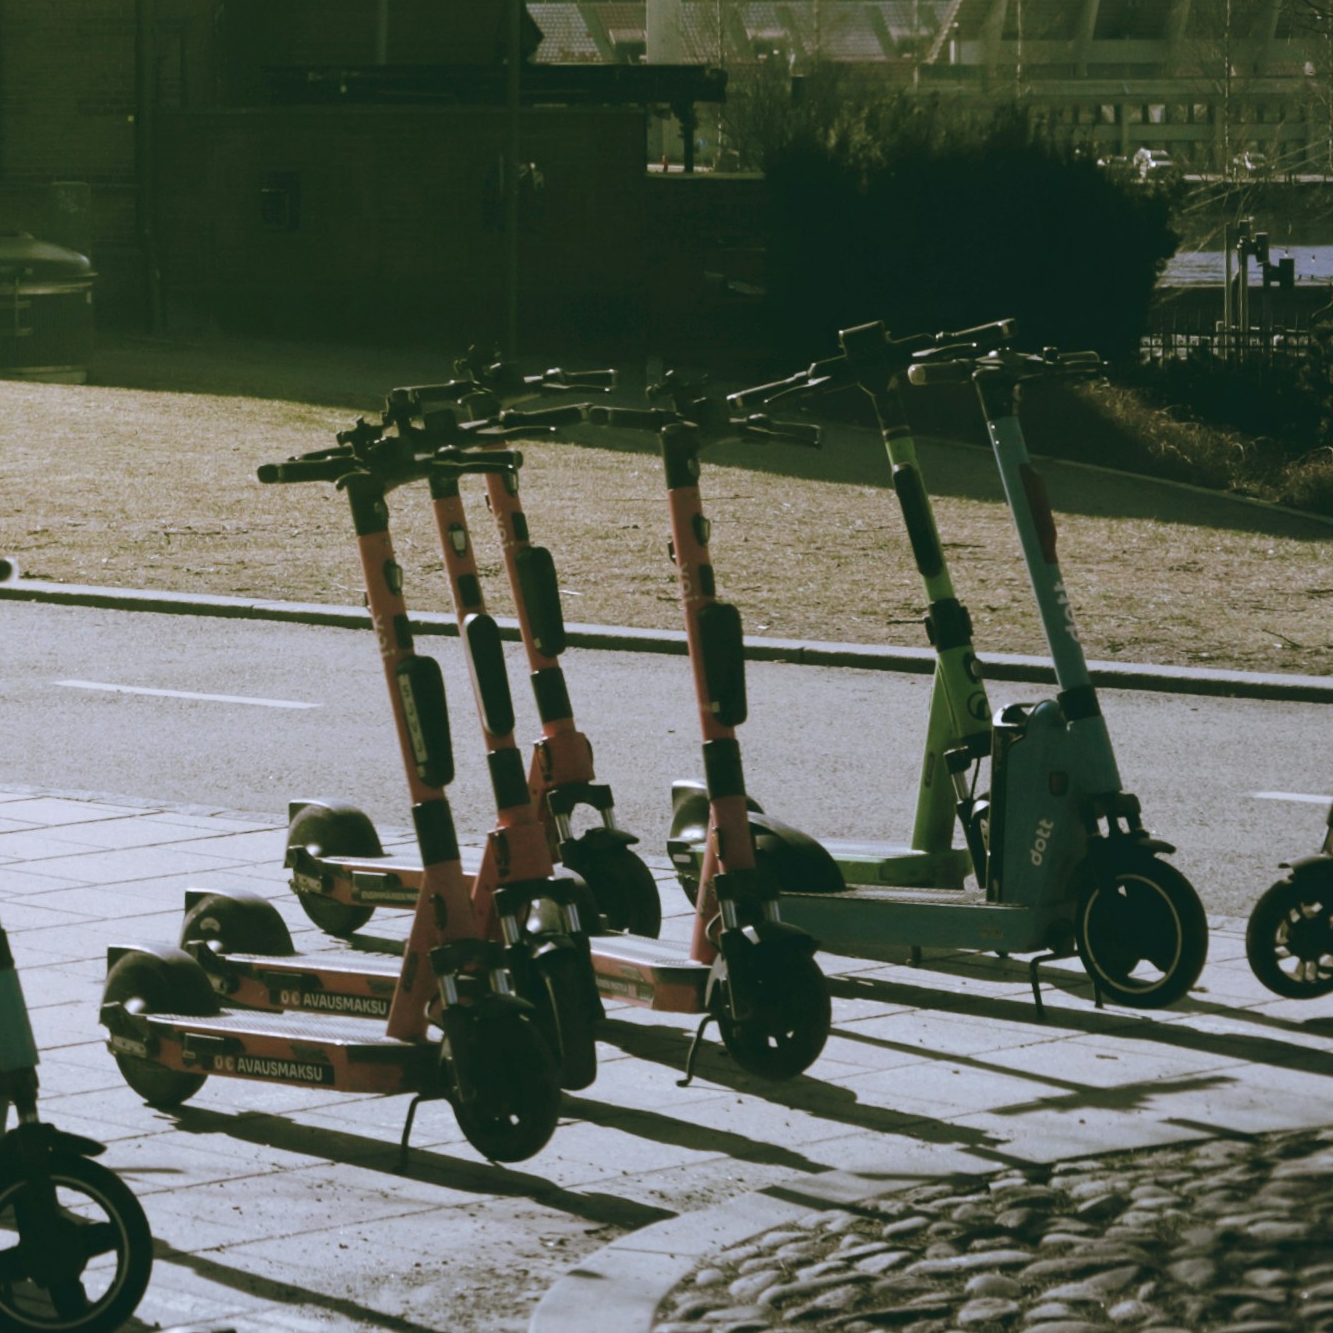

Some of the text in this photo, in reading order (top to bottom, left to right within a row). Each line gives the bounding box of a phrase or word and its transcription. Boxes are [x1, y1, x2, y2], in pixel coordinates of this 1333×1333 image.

[1030, 818, 1054, 866] dott
[303, 992, 388, 1015] AVAUSMAKSU
[237, 1057, 323, 1082] AVAUSMAKSU
